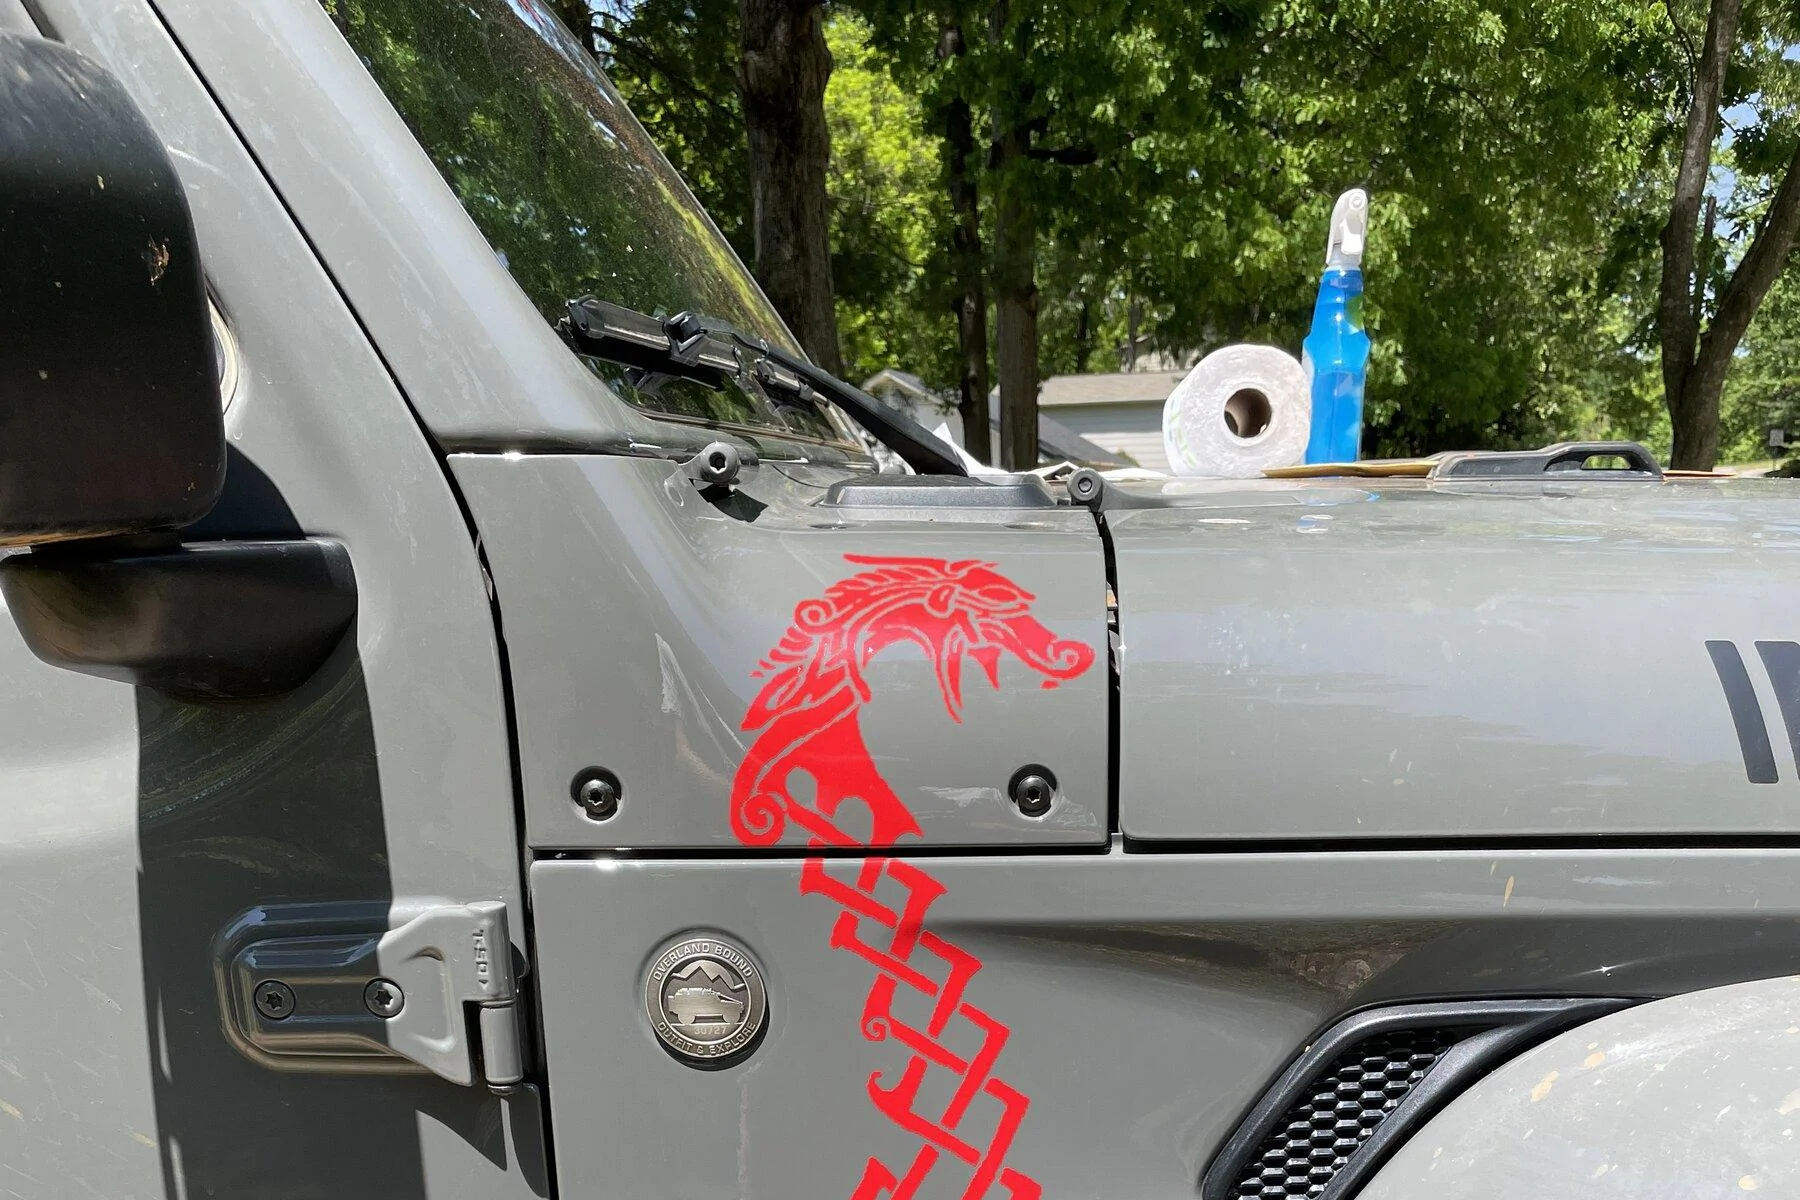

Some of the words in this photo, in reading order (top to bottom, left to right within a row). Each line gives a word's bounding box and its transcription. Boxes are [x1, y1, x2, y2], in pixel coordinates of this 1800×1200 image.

[653, 942, 710, 981] OVERLAND
[714, 946, 753, 978] BOUND
[657, 1021, 692, 1050] OUTFIT
[696, 1044, 704, 1054] &
[708, 1022, 756, 1054] EXPLORE
